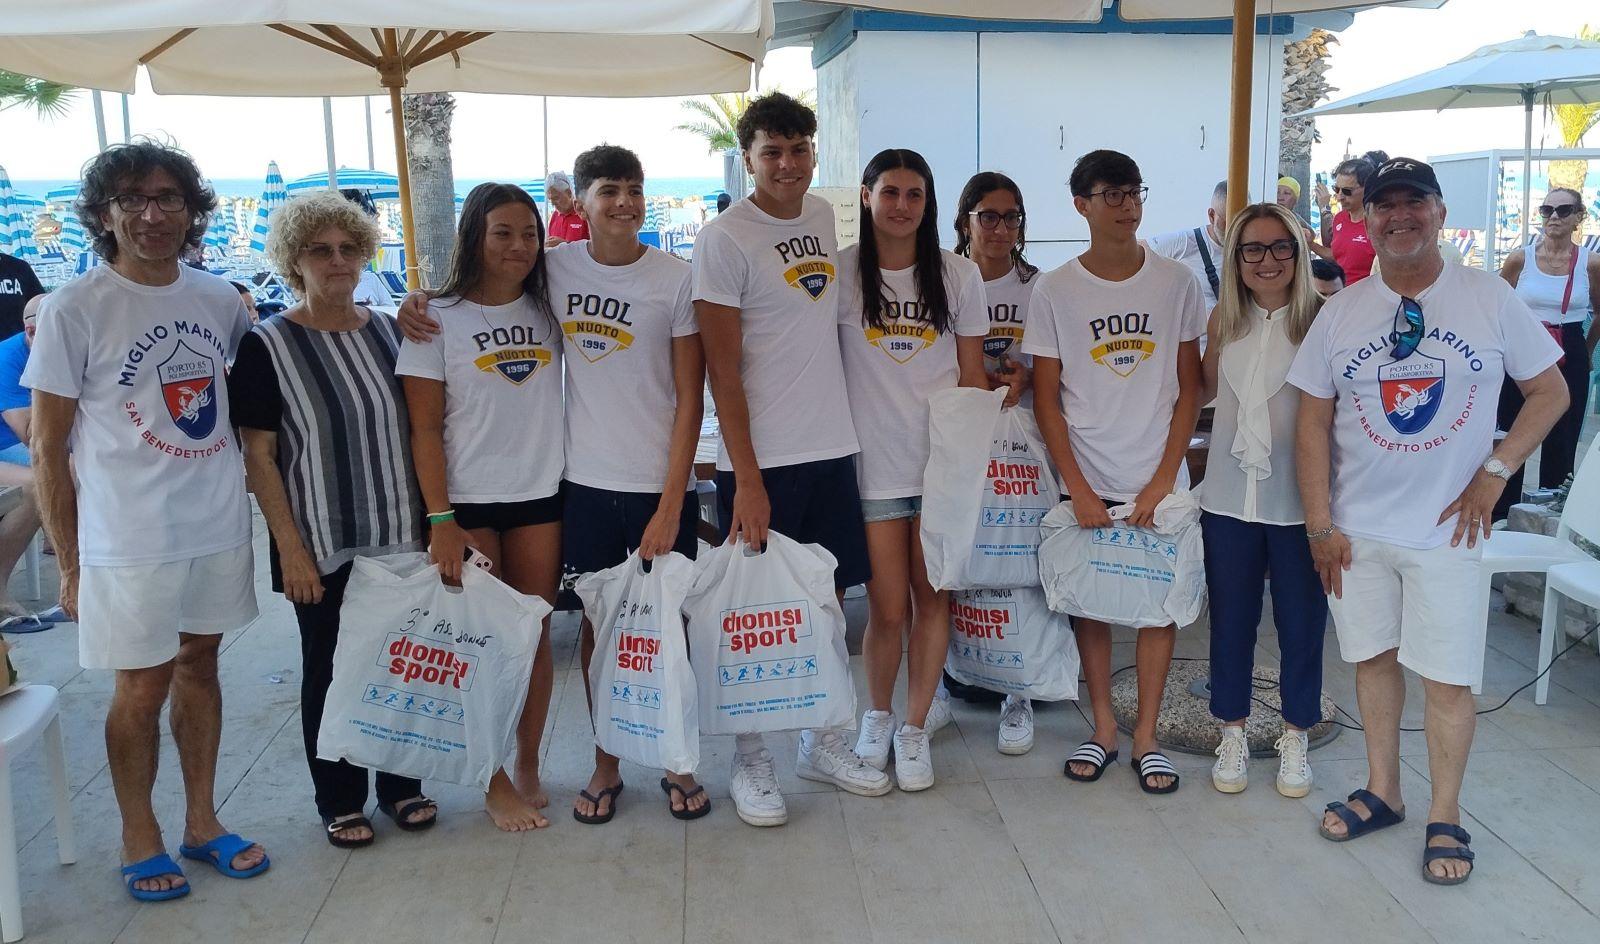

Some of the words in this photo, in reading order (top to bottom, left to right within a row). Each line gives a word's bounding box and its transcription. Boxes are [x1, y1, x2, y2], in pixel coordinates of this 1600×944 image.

[774, 234, 828, 264] POOL
[795, 262, 826, 276] NUOTO
[0, 278, 23, 296] ICA
[806, 279, 823, 288] 1996
[567, 293, 632, 327] POOL
[882, 301, 935, 323] OOL
[576, 322, 619, 338] NUOTO
[1089, 312, 1152, 340] POOL
[473, 325, 542, 351] POOL
[582, 339, 606, 351] 1996
[890, 341, 914, 351] 1996
[984, 341, 1006, 350] 1996
[1105, 339, 1142, 352] NUOTO
[118, 325, 168, 387] MIGLIO
[174, 320, 226, 358] MARIN
[494, 350, 536, 361] NUOTO
[1427, 327, 1483, 372] ARINO
[167, 362, 195, 373] PORTO
[505, 364, 530, 374] 1996
[1114, 355, 1135, 366] 1996
[1390, 364, 1422, 373] PORTO
[1424, 362, 1434, 370] 85
[1360, 416, 1420, 452] BENEDETTO
[1424, 435, 1448, 451] DEL
[1450, 384, 1478, 432] TRONTO
[125, 401, 144, 427] SAN
[141, 430, 212, 458] BENEDETTO
[214, 436, 228, 450] DE
[723, 608, 802, 633] dionisi
[949, 600, 1010, 624] dionisi
[954, 618, 1005, 640] sport
[731, 627, 798, 655] sport
